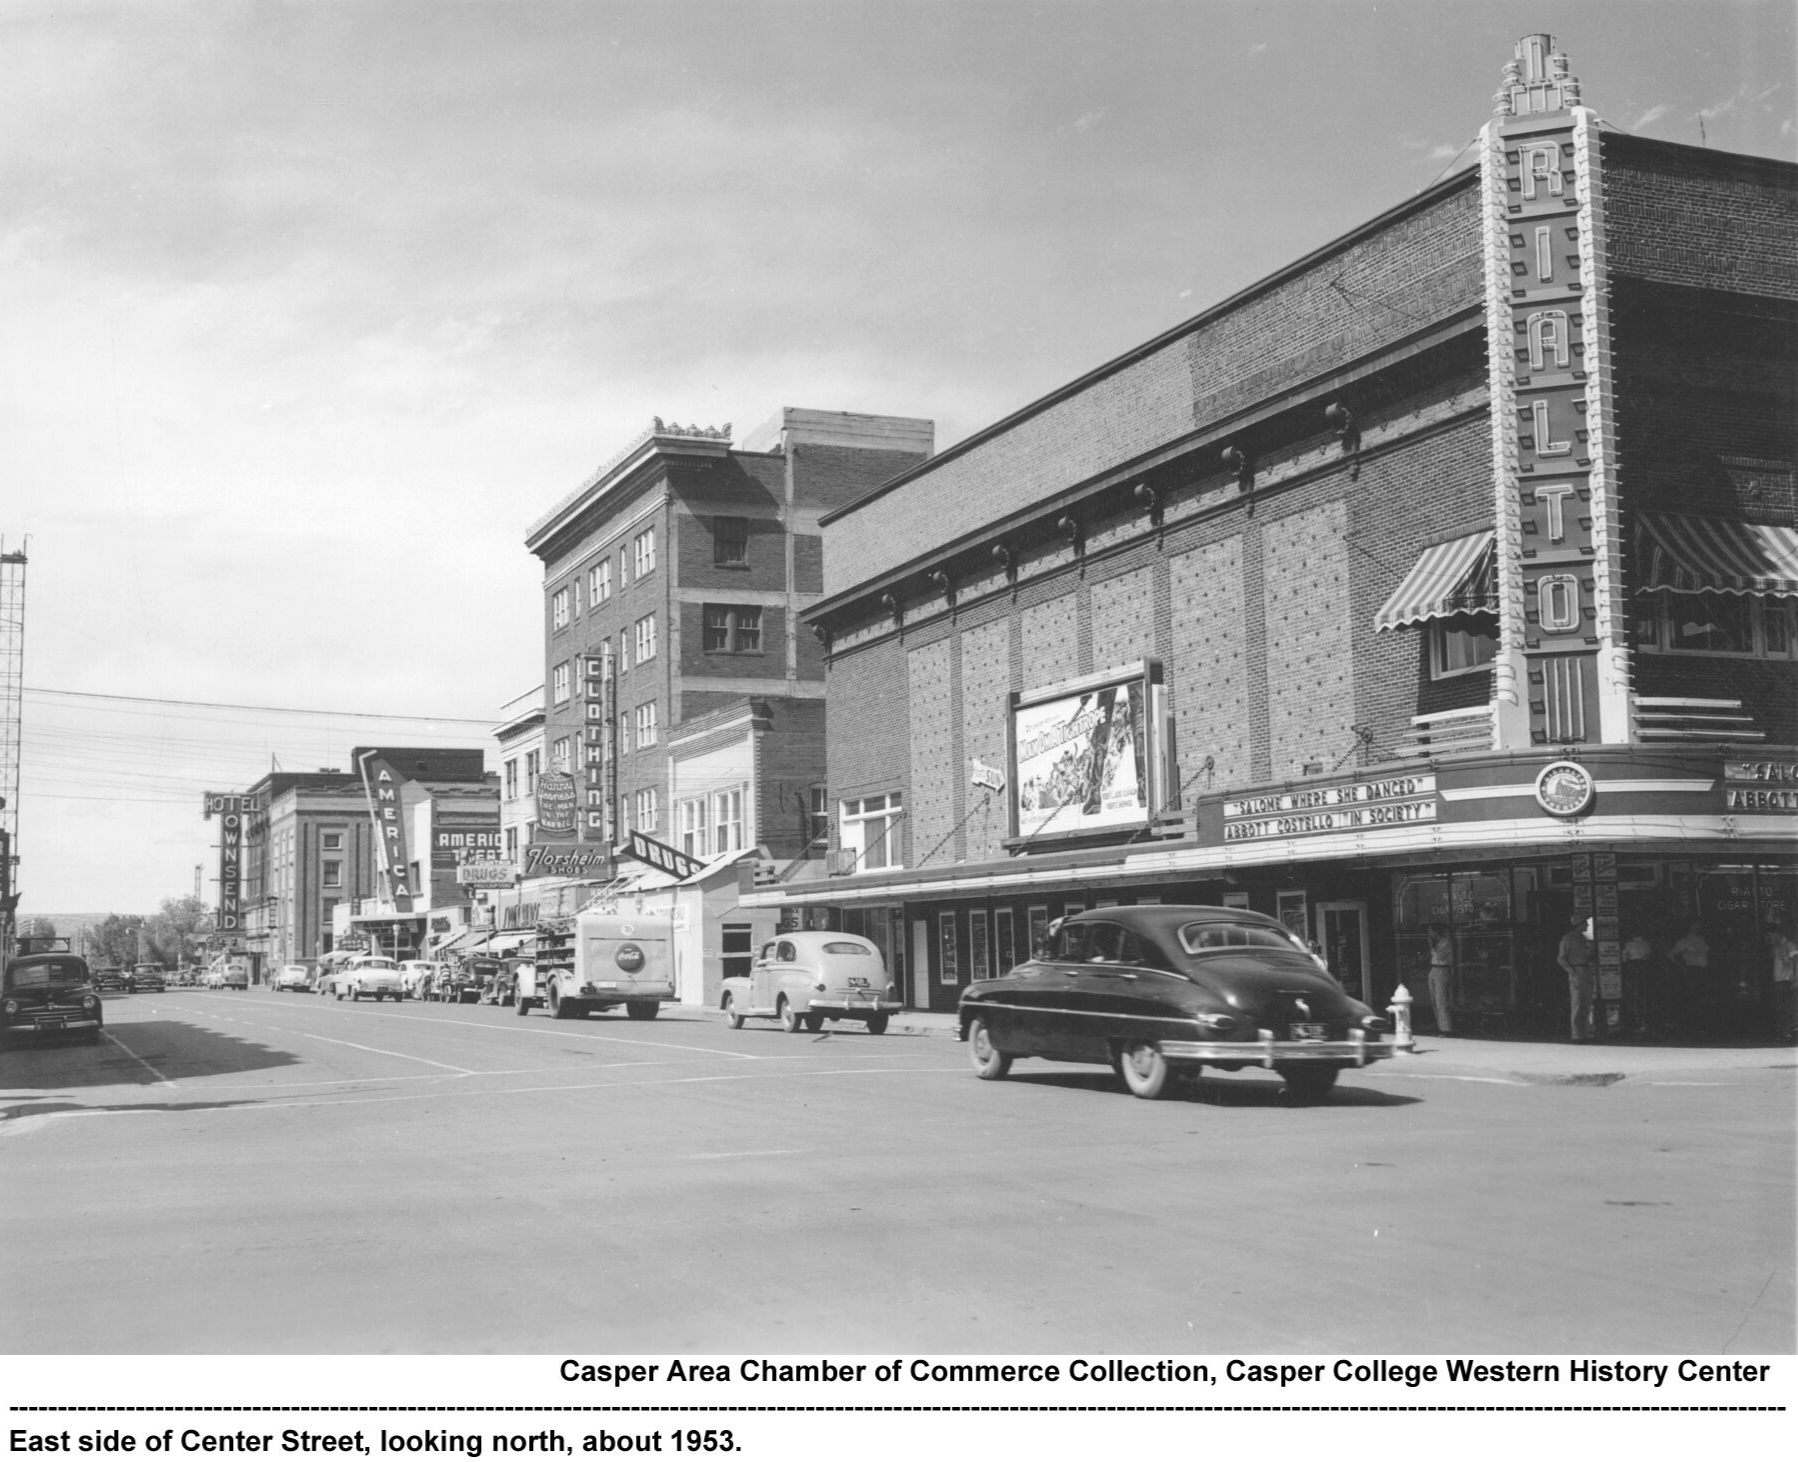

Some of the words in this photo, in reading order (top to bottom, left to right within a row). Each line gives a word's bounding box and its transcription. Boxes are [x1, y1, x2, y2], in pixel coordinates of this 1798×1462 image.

[1517, 140, 1580, 632] RIALTO
[587, 660, 601, 828] CLOTHING
[206, 796, 260, 812] HOTEL
[1291, 790, 1327, 810] WHERE
[1337, 786, 1357, 804] SHE
[378, 769, 410, 897] AMERICA
[1226, 821, 1270, 839] ABBOTT
[1278, 813, 1333, 834] COSTELLO
[528, 847, 605, 873] Florsheim
[551, 865, 589, 874] SHOES
[463, 868, 508, 881] DRUGS
[1731, 887, 1774, 897] RIATO
[1758, 900, 1787, 911] TORE
